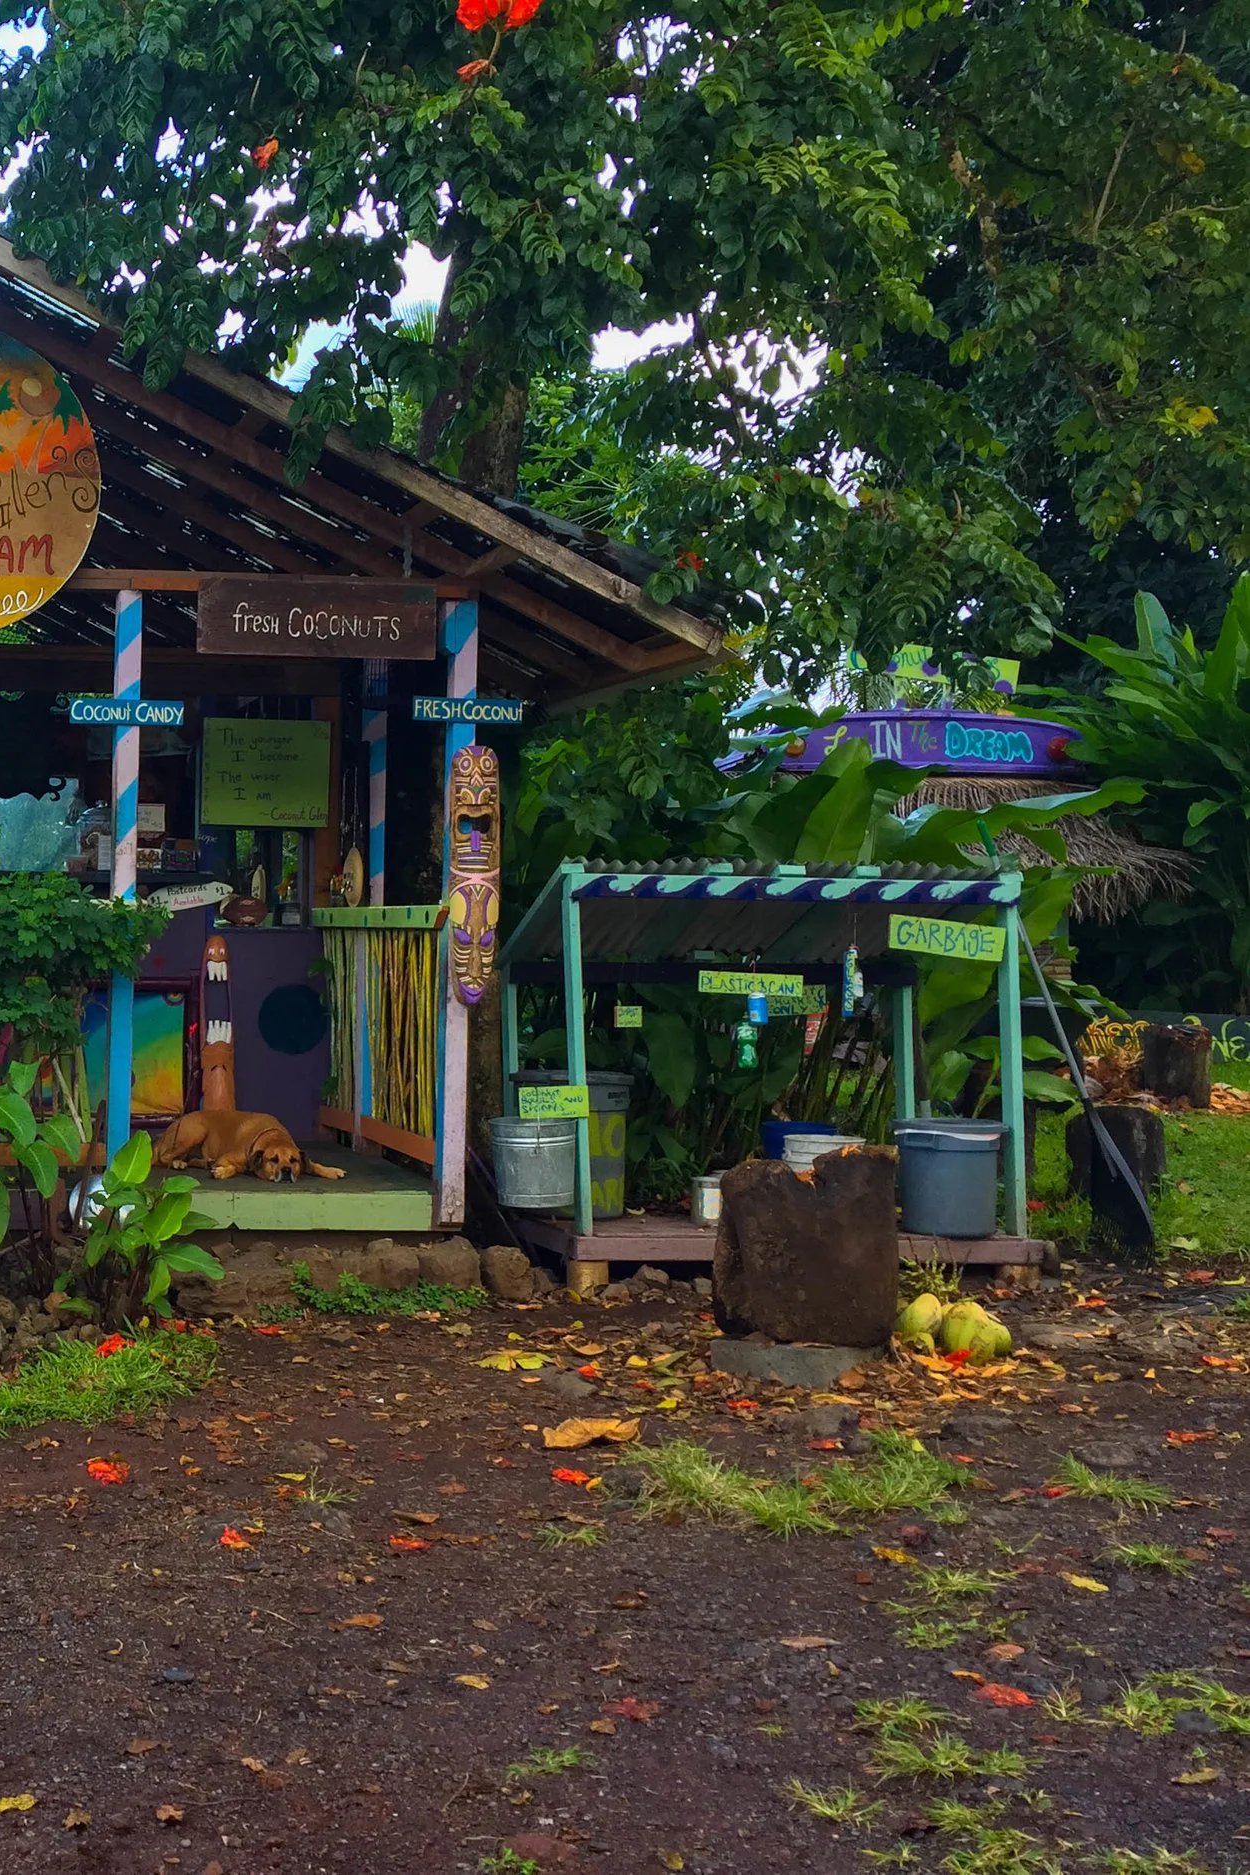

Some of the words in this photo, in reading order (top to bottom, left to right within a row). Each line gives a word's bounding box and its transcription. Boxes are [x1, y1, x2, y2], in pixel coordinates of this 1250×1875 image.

[135, 702, 184, 725] CANDY
[414, 699, 462, 719] FRESH
[216, 727, 244, 746] The
[945, 721, 1033, 762] DREAM
[231, 750, 244, 762] I
[217, 771, 242, 783] The
[233, 787, 246, 800] I
[167, 885, 208, 896] Postcards
